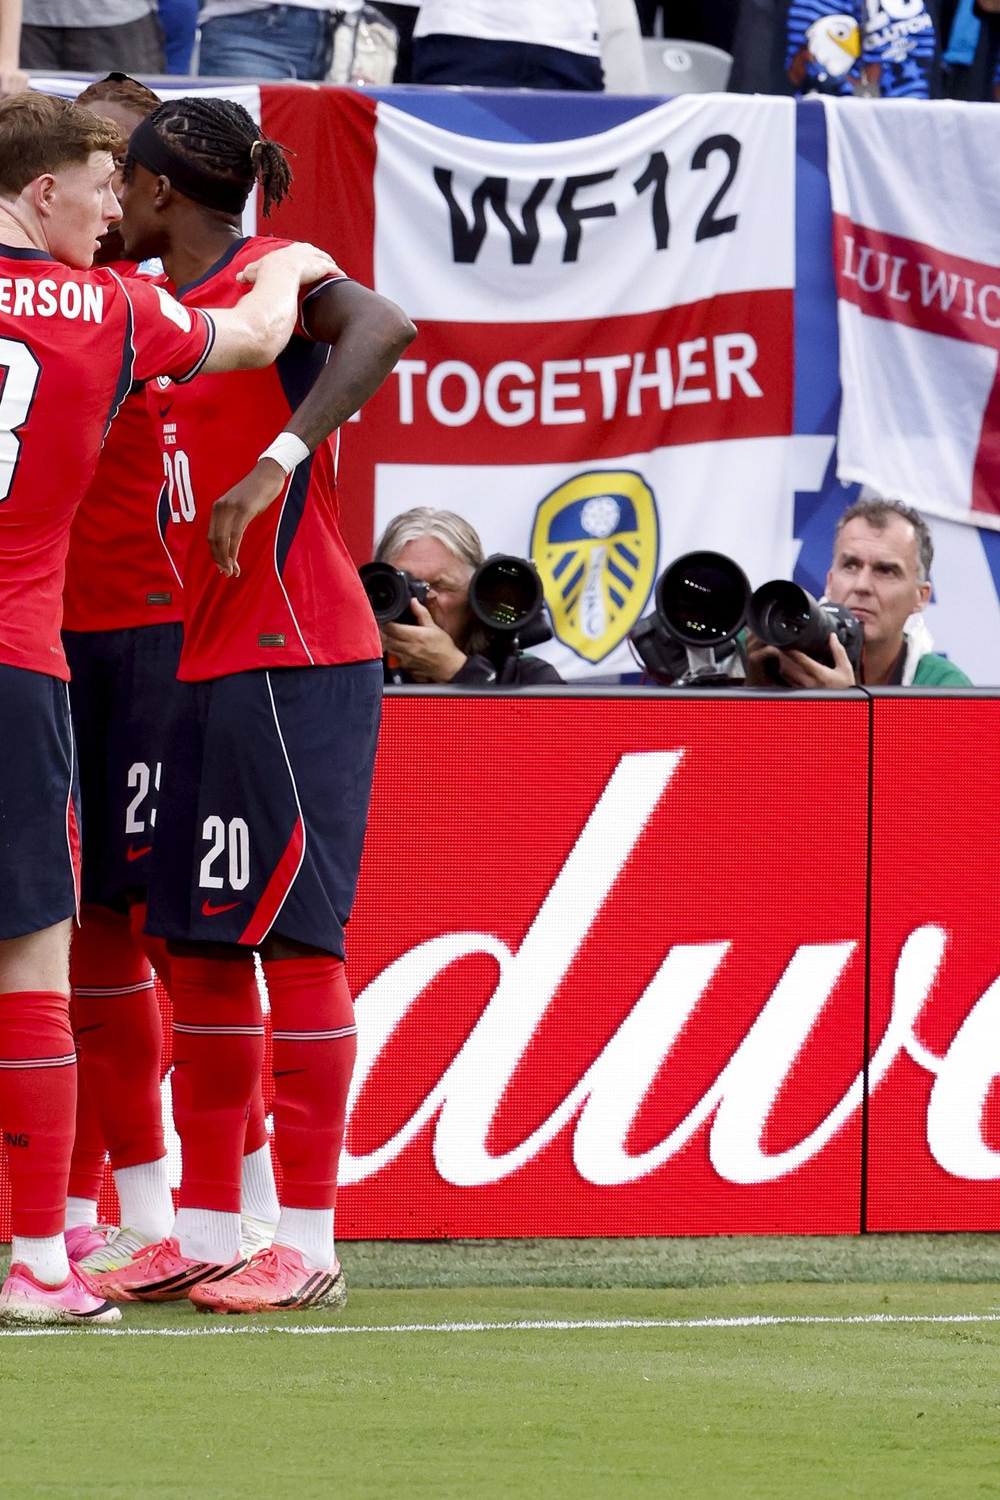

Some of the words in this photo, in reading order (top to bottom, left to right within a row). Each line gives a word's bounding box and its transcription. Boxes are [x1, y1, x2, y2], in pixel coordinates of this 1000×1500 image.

[392, 333, 764, 427] TOGETHER
[163, 450, 196, 523] 20
[199, 815, 250, 891] 20
